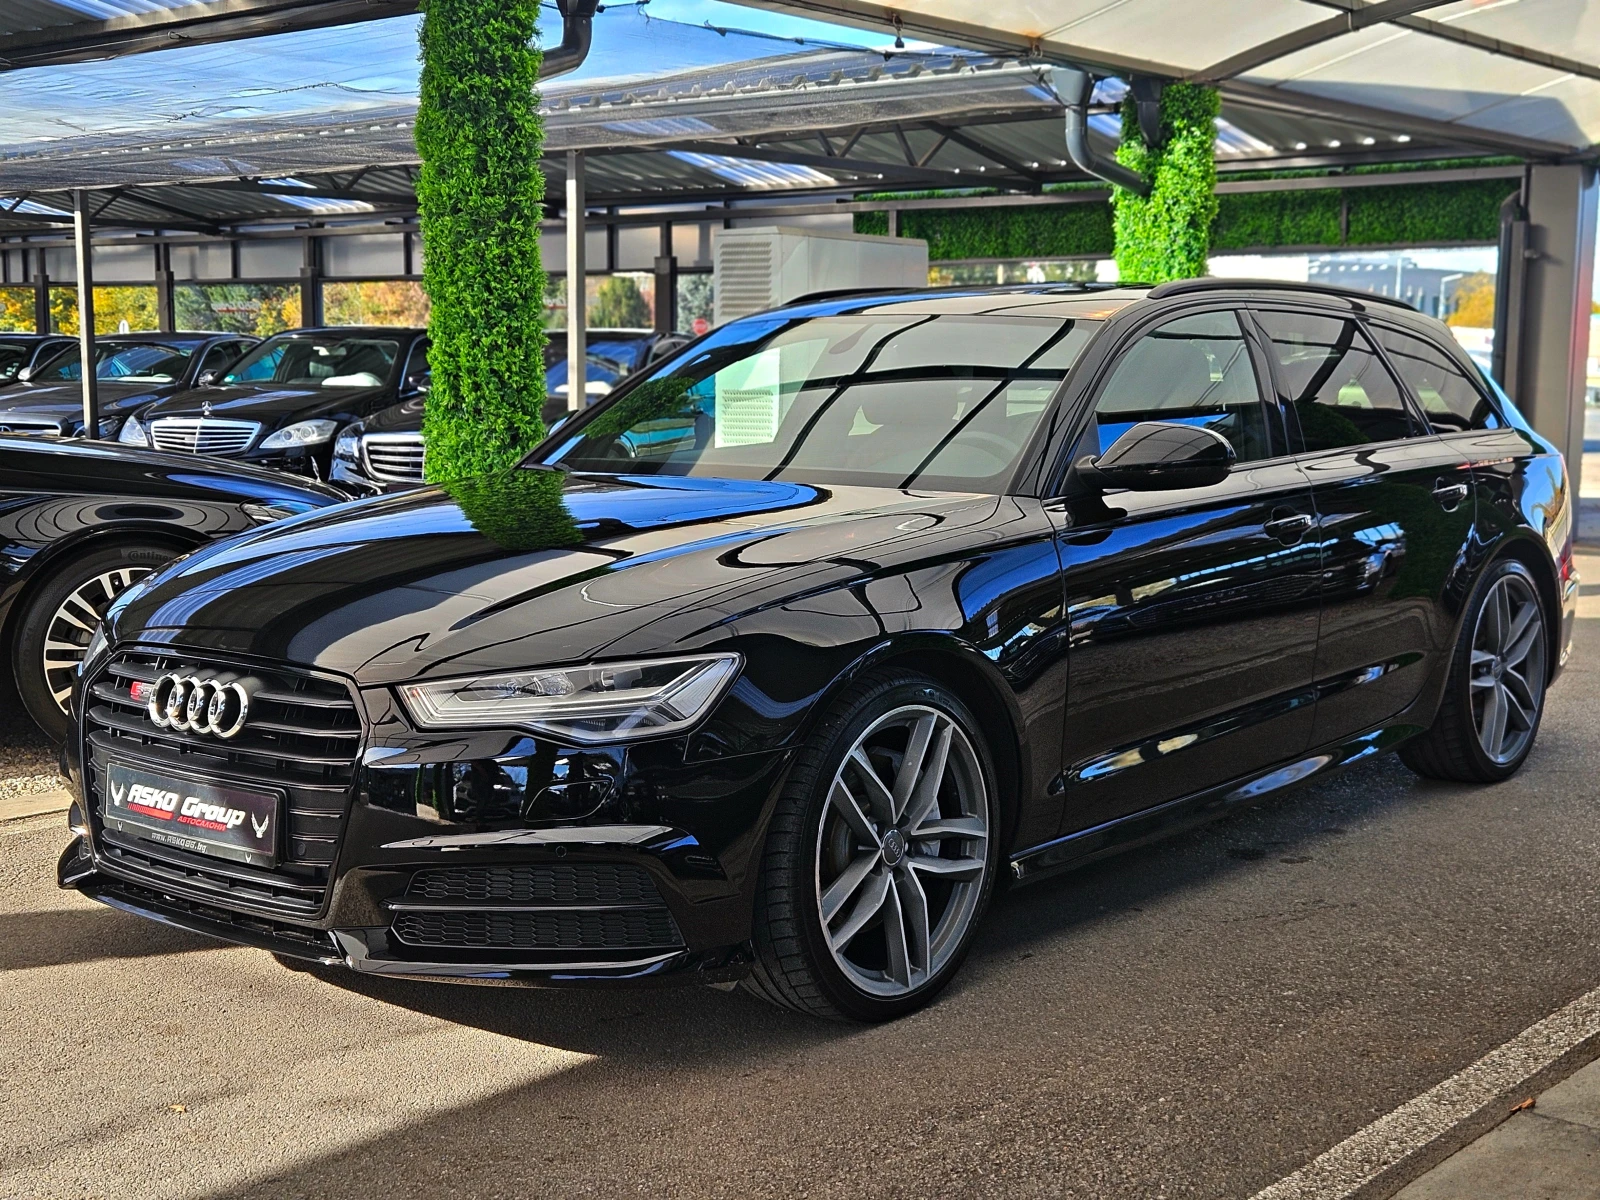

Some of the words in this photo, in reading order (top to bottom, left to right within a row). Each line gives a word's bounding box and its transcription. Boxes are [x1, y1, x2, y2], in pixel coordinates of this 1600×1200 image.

[127, 783, 179, 811] ASKO
[181, 796, 246, 829] Group
[177, 815, 227, 831] АВТОСАЛОНИ
